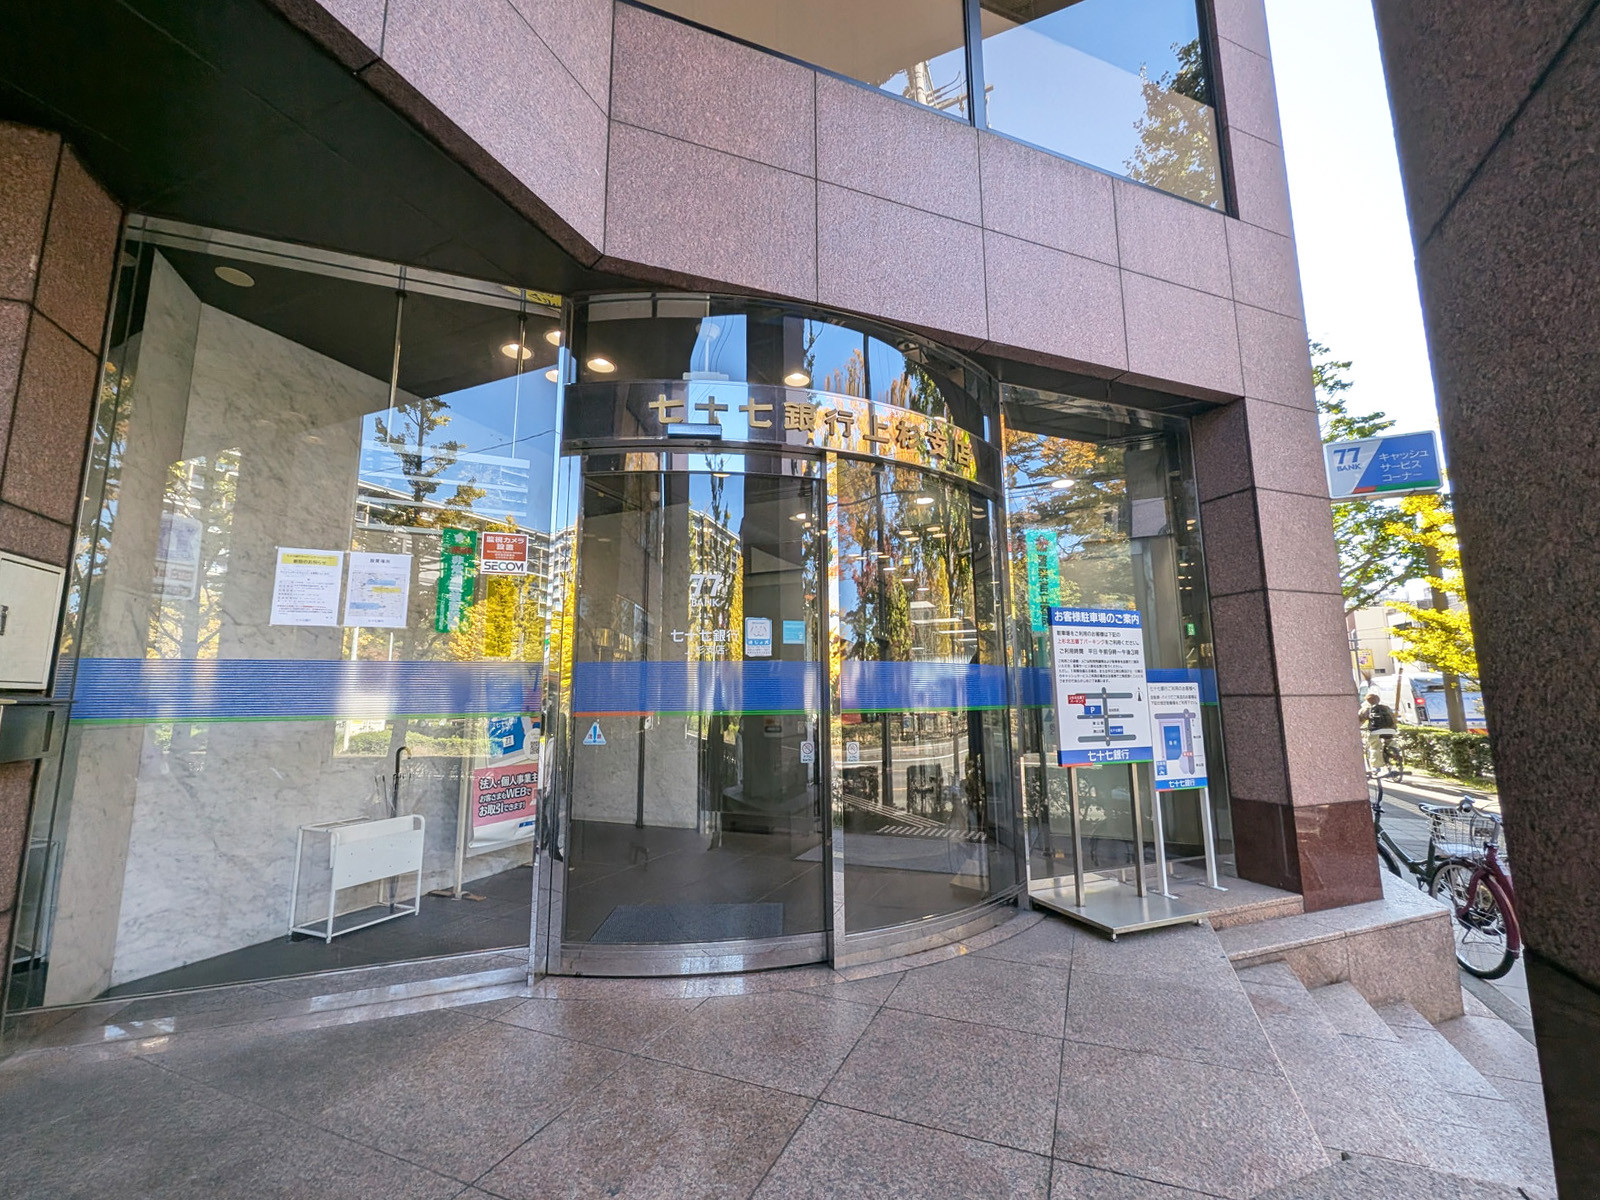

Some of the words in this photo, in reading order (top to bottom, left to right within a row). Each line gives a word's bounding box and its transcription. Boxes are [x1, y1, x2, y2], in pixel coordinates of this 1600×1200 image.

[648, 393, 974, 468] 七十七銀行上杉支店
[1334, 446, 1361, 464] 77
[1379, 449, 1429, 462] キャッシュ
[1337, 463, 1361, 472] BANK
[1380, 460, 1422, 472] サービス
[1382, 471, 1422, 482] コーナー
[486, 535, 525, 545] 監視カメラ
[484, 561, 524, 572] SECOM
[690, 573, 722, 597] 77
[691, 599, 719, 607] BANK
[1054, 610, 1140, 625] お客様駐車場のご案内
[671, 628, 739, 643] 七十七銀行
[1087, 749, 1130, 761] 七十七銀行
[479, 771, 538, 789] 法人・個人事業主
[1168, 779, 1195, 788] 七十七銀行
